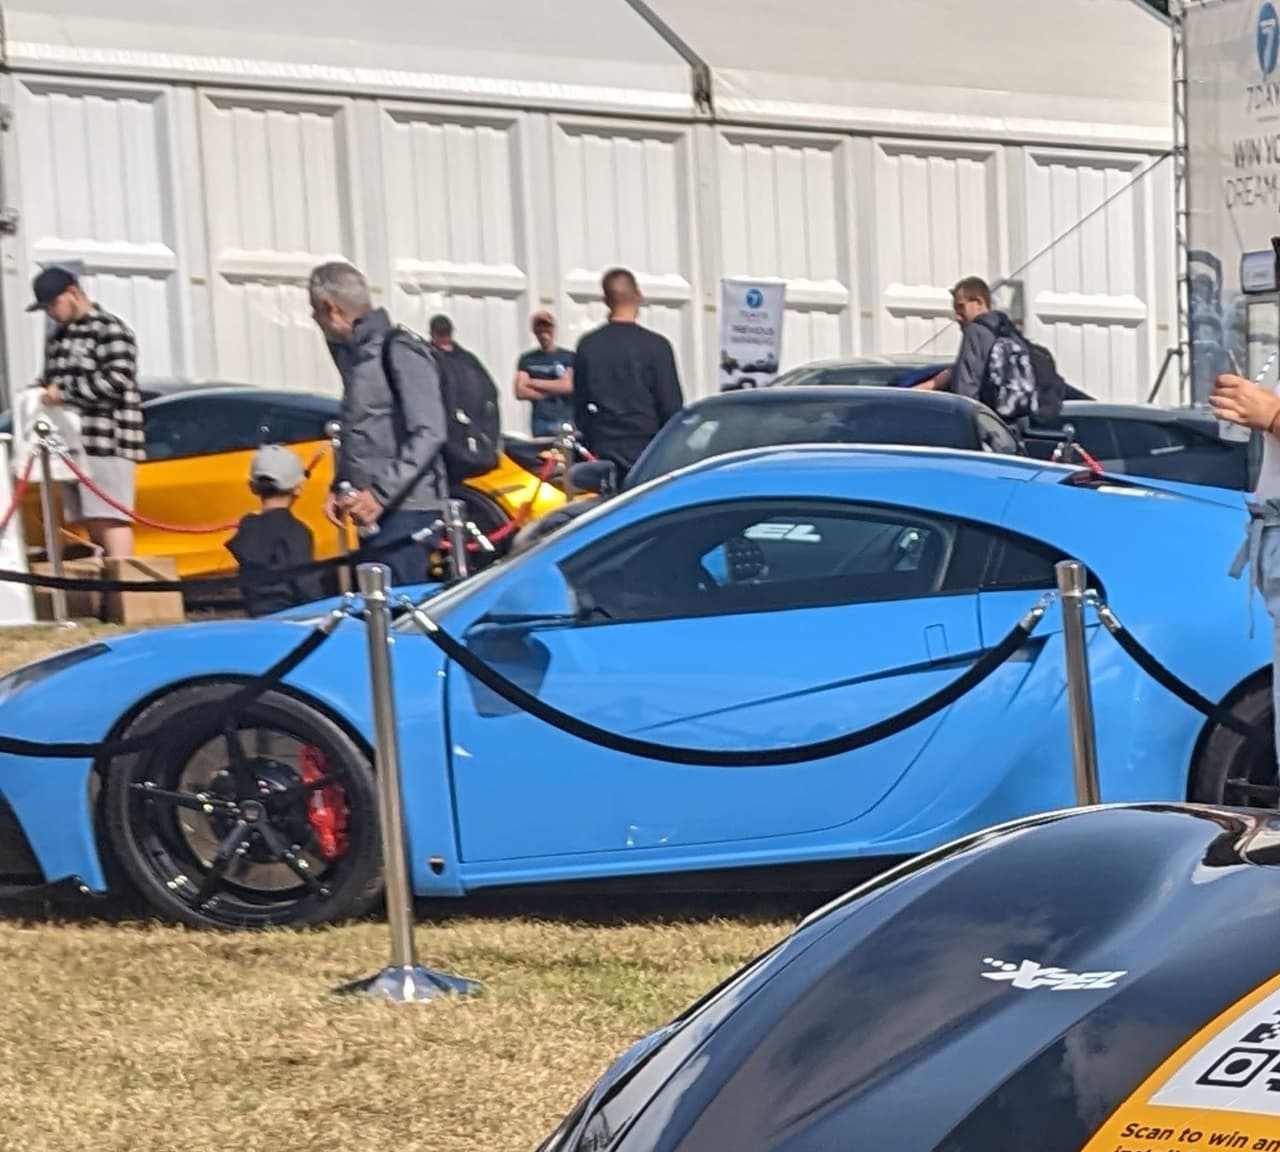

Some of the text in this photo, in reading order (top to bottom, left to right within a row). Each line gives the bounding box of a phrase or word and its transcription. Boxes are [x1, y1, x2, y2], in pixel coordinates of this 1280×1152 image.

[1233, 136, 1262, 169] WIN
[981, 958, 1129, 992] XPEL
[1121, 1122, 1174, 1142] Scan
[1179, 1127, 1203, 1144] to
[1208, 1130, 1249, 1149] win
